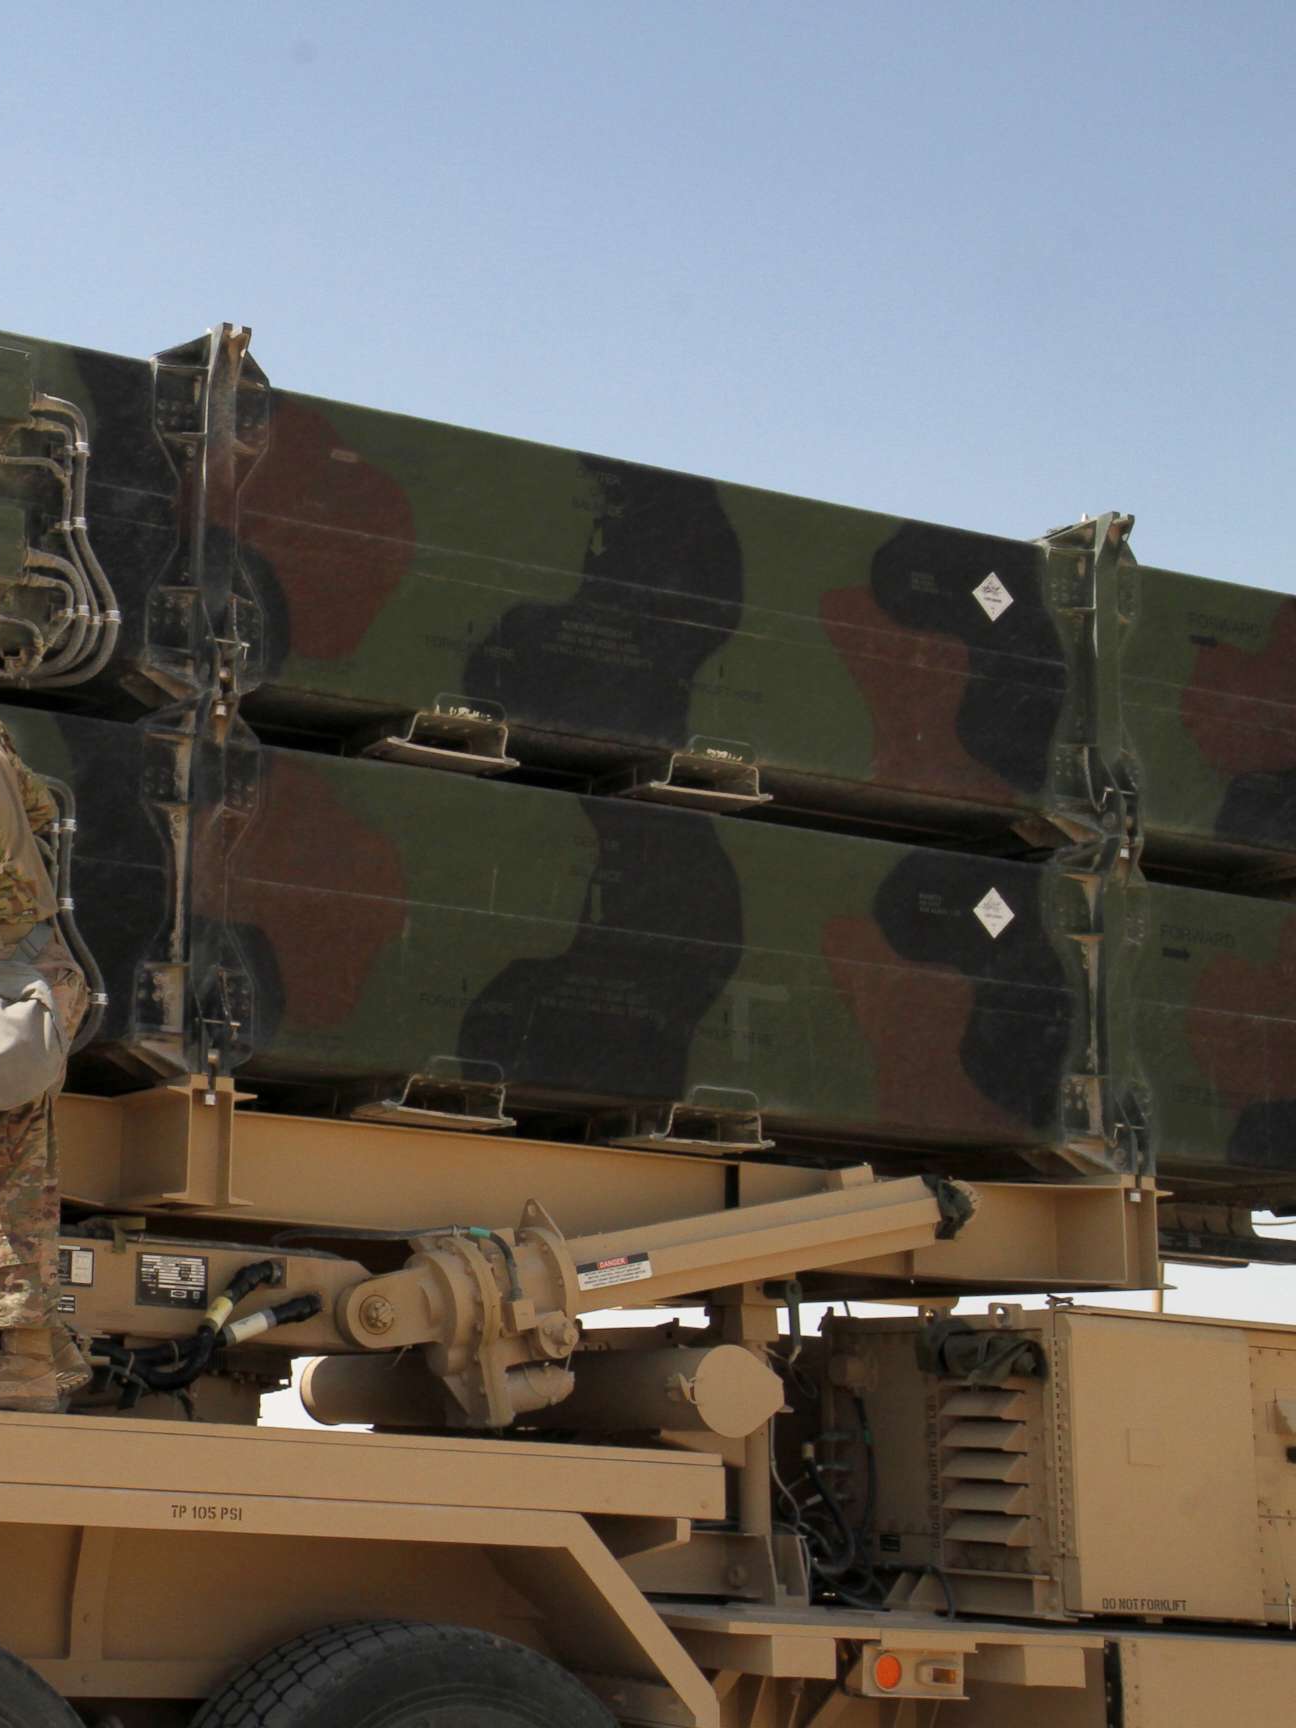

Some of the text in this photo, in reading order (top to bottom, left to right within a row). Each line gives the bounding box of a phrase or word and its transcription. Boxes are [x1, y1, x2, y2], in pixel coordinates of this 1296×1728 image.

[1160, 923, 1235, 949] FORWARD
[599, 1257, 626, 1269] DANGER
[171, 1504, 242, 1521] TP 105 PSI
[1102, 1598, 1186, 1611] DO NOT FORKLIFT
